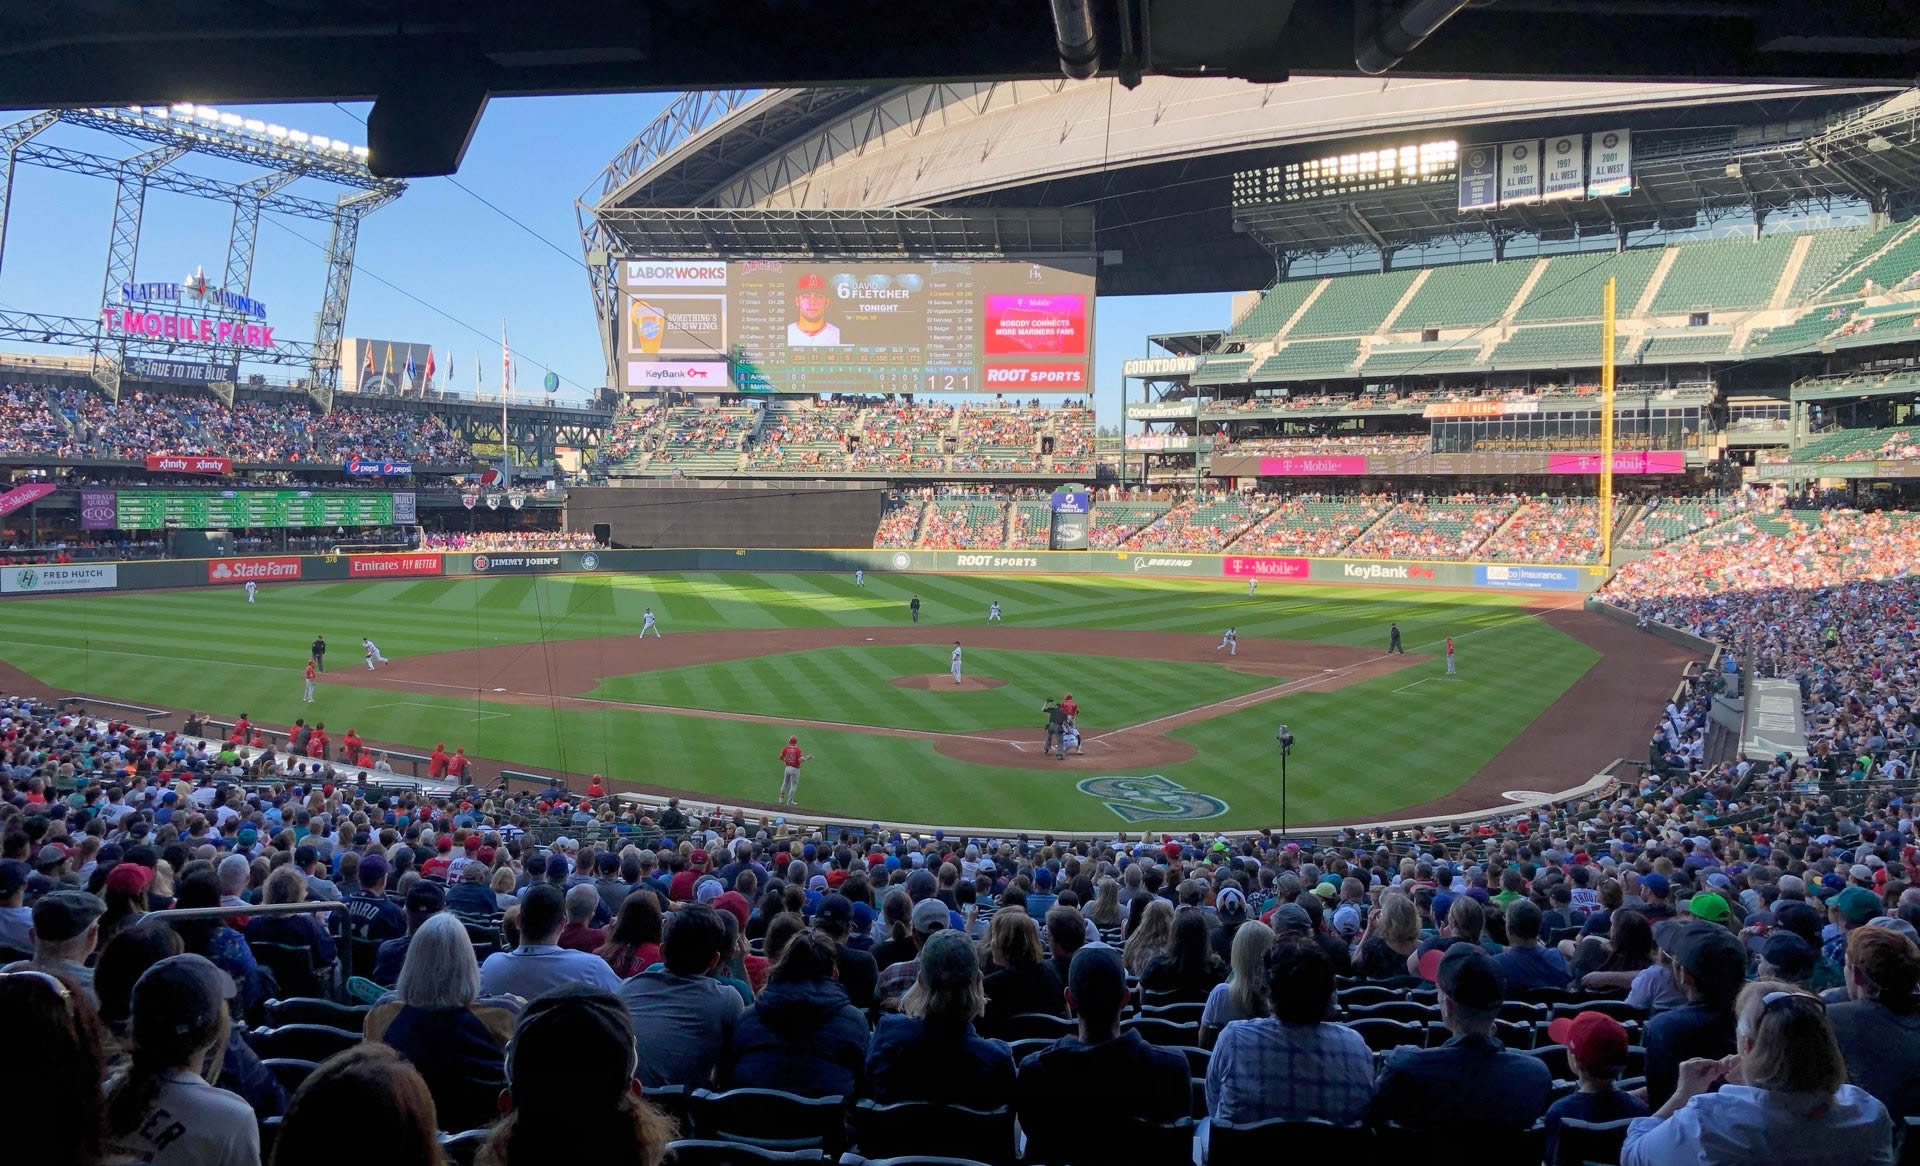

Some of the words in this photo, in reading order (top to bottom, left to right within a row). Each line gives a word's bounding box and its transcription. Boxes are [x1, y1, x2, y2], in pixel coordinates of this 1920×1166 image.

[1556, 159, 1571, 168] 1997
[1602, 153, 1618, 163] 2001
[1513, 165, 1528, 174] 1995
[1607, 163, 1624, 174] WEST
[1517, 176, 1534, 186] WEST
[1561, 170, 1577, 181] WEST
[1503, 187, 1537, 200] CHAMPIONS
[838, 283, 850, 298] 6
[852, 290, 909, 299] FLETCHER
[120, 282, 181, 302] SEATTLE
[212, 288, 267, 319] MARINERS
[859, 304, 898, 312] TONIGHT
[667, 313, 717, 322] SOMETHING'S
[102, 308, 213, 342] T-MOBILE
[217, 321, 276, 348] PARK
[667, 322, 719, 330] BREWING
[1056, 328, 1074, 336] FANS
[146, 358, 170, 377] TRUE
[172, 363, 184, 377] TO
[186, 364, 203, 378] THE
[204, 364, 229, 380] BLUE
[1125, 357, 1196, 374] COUNTDOWN
[646, 369, 685, 379] KeyBank
[987, 369, 1029, 381] ROOT
[1030, 371, 1081, 381] SPORTS
[928, 375, 935, 390] 1
[944, 375, 954, 390] 2
[961, 375, 969, 390] 1
[1128, 405, 1193, 417] COOPERSTOWN
[1172, 437, 1189, 448] DAY
[159, 459, 188, 470] xfinity
[196, 460, 223, 471] xfinity
[360, 464, 379, 473] pepsi
[394, 465, 412, 474] pepsi
[1760, 464, 1817, 477] HORNITOS
[395, 496, 414, 504] BUILT
[395, 512, 414, 520] TOUGH
[354, 560, 399, 572] Emirates
[402, 560, 414, 570] FLY
[415, 558, 437, 570] BETTER
[491, 558, 524, 567] JIMMY
[526, 557, 559, 566] JOHN'S
[957, 555, 993, 566] ROOT
[994, 557, 1037, 567] SPORTS
[1148, 558, 1193, 567] BOEING
[44, 571, 69, 579] FRED
[72, 569, 103, 578] HUTCH
[1344, 564, 1408, 580] KeyBank
[1521, 570, 1563, 580] Insurance
[348, 901, 380, 921] HIRO
[139, 1108, 187, 1151] ER
